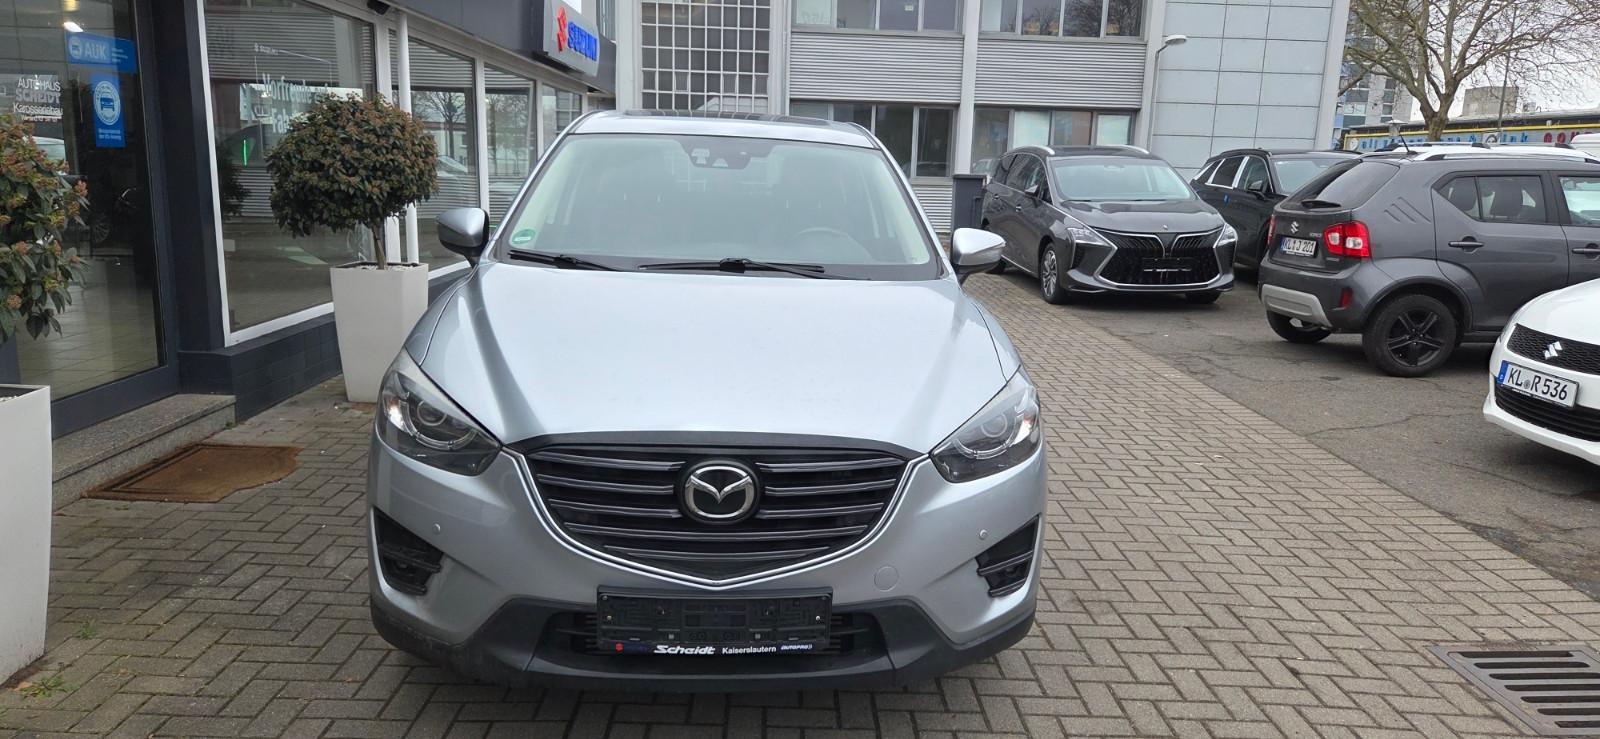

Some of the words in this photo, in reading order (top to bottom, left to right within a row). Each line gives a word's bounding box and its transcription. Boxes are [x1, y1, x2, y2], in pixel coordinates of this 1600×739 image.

[17, 78, 61, 92] AUTOHAUS
[262, 73, 312, 104] Vorfreude
[1507, 367, 1523, 387] KL
[1530, 375, 1542, 392] R
[1541, 378, 1568, 400] 536
[653, 644, 716, 655] Scheidt
[721, 645, 777, 655] Kaiserslautern
